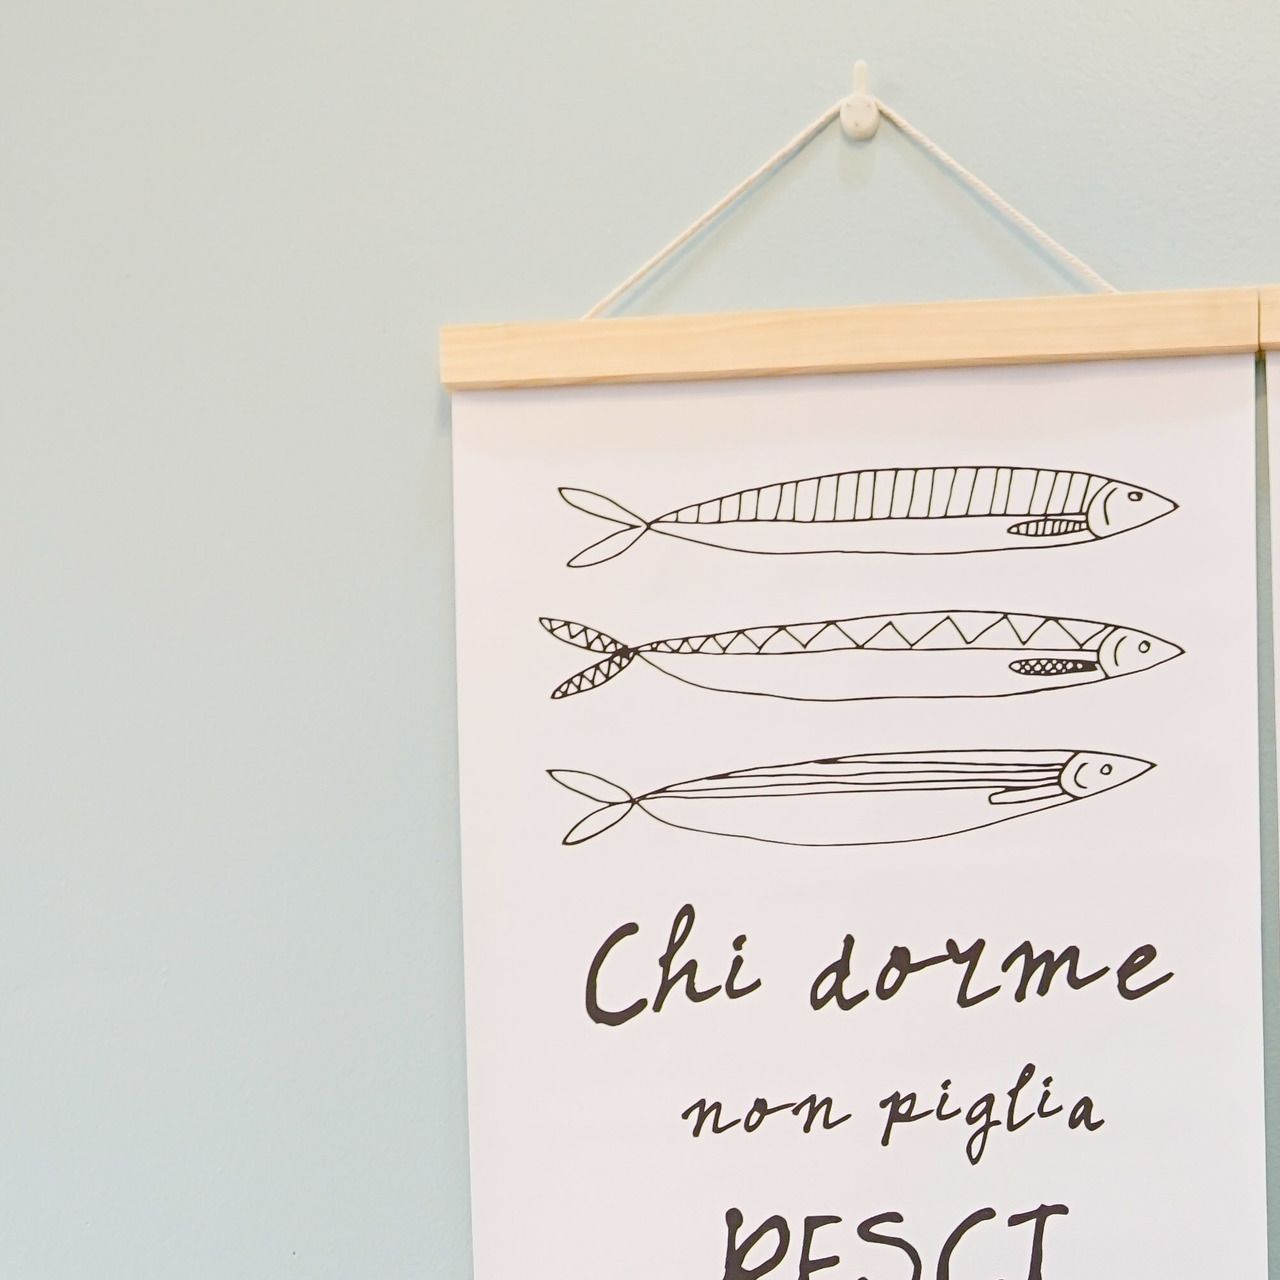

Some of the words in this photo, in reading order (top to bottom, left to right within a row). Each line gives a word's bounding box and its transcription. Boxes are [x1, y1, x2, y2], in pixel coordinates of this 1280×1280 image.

[586, 904, 761, 1026] Chi
[810, 934, 1174, 1011] dorme
[682, 1094, 851, 1137] non
[879, 1063, 1104, 1165] piglia
